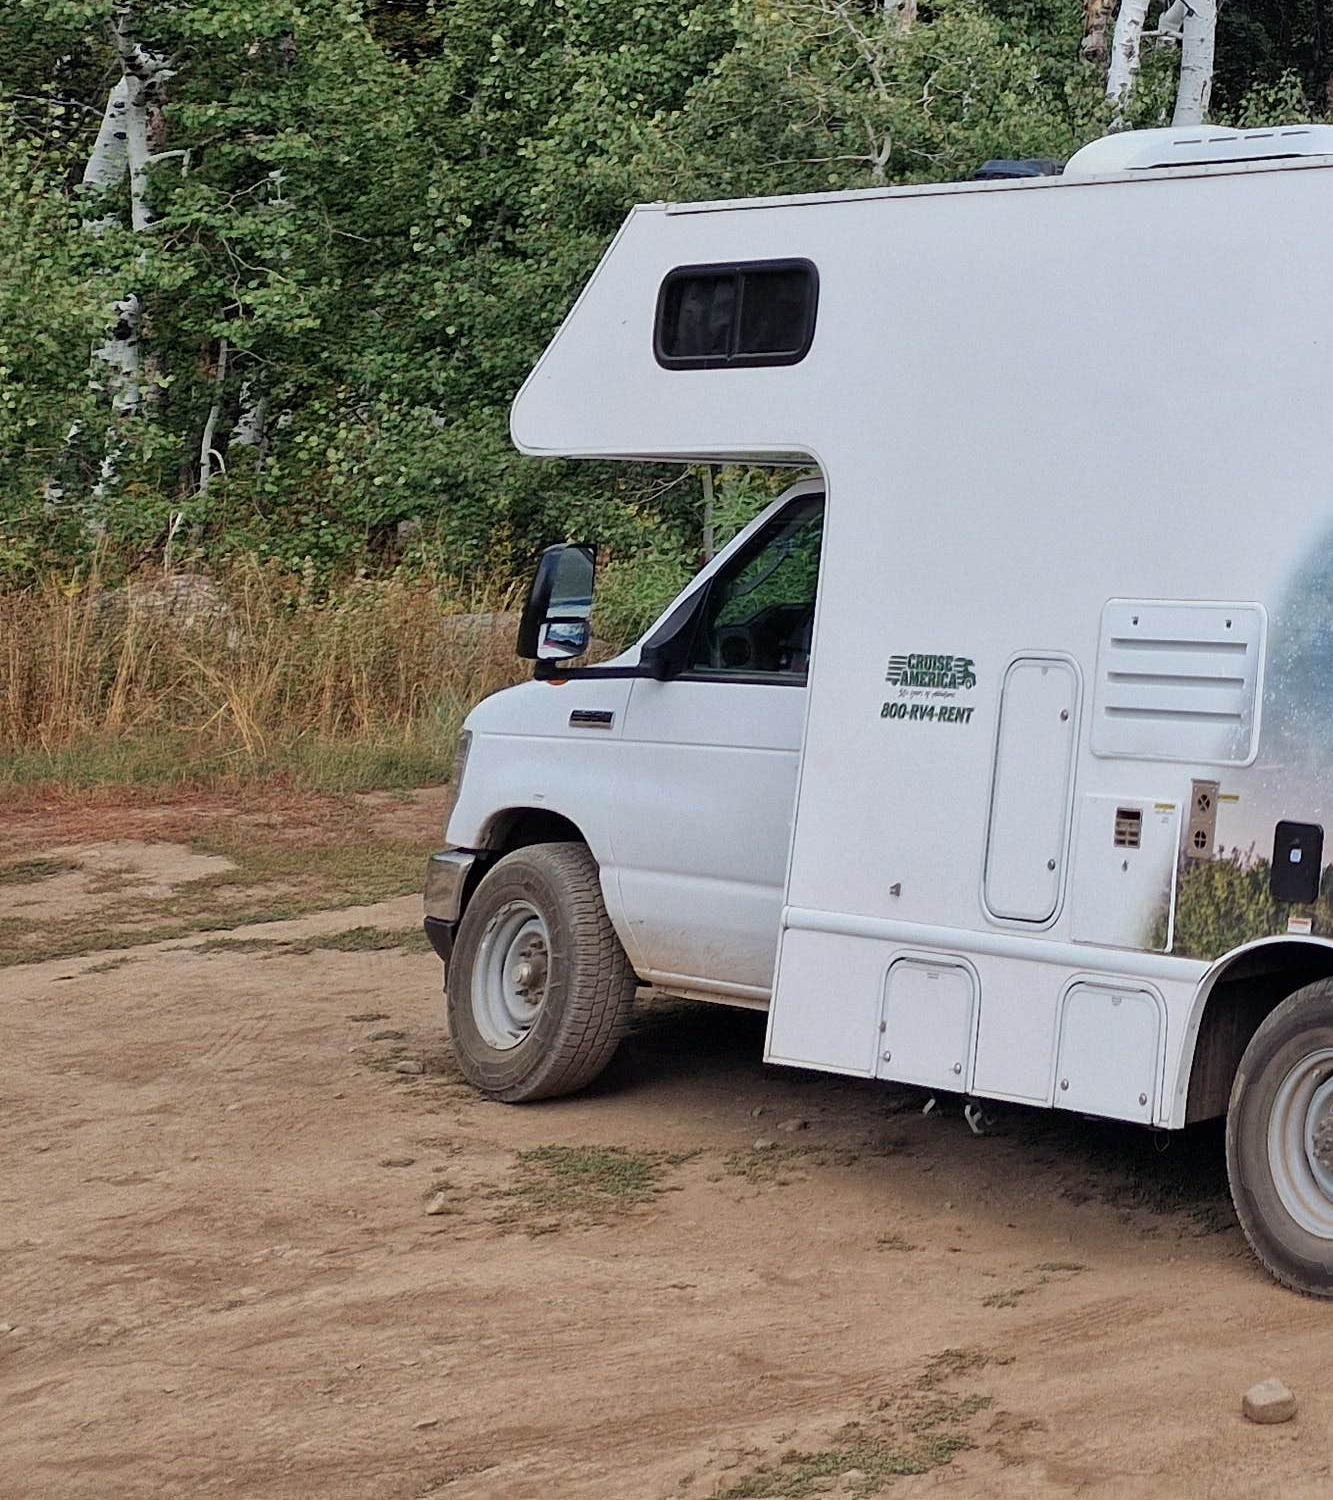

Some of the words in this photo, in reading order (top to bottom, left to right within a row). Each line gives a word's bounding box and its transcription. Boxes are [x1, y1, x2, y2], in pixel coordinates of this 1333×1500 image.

[907, 653, 954, 672] CRUISE
[900, 670, 957, 689] AMERICA
[880, 702, 975, 724] 800-RV4-RENT
